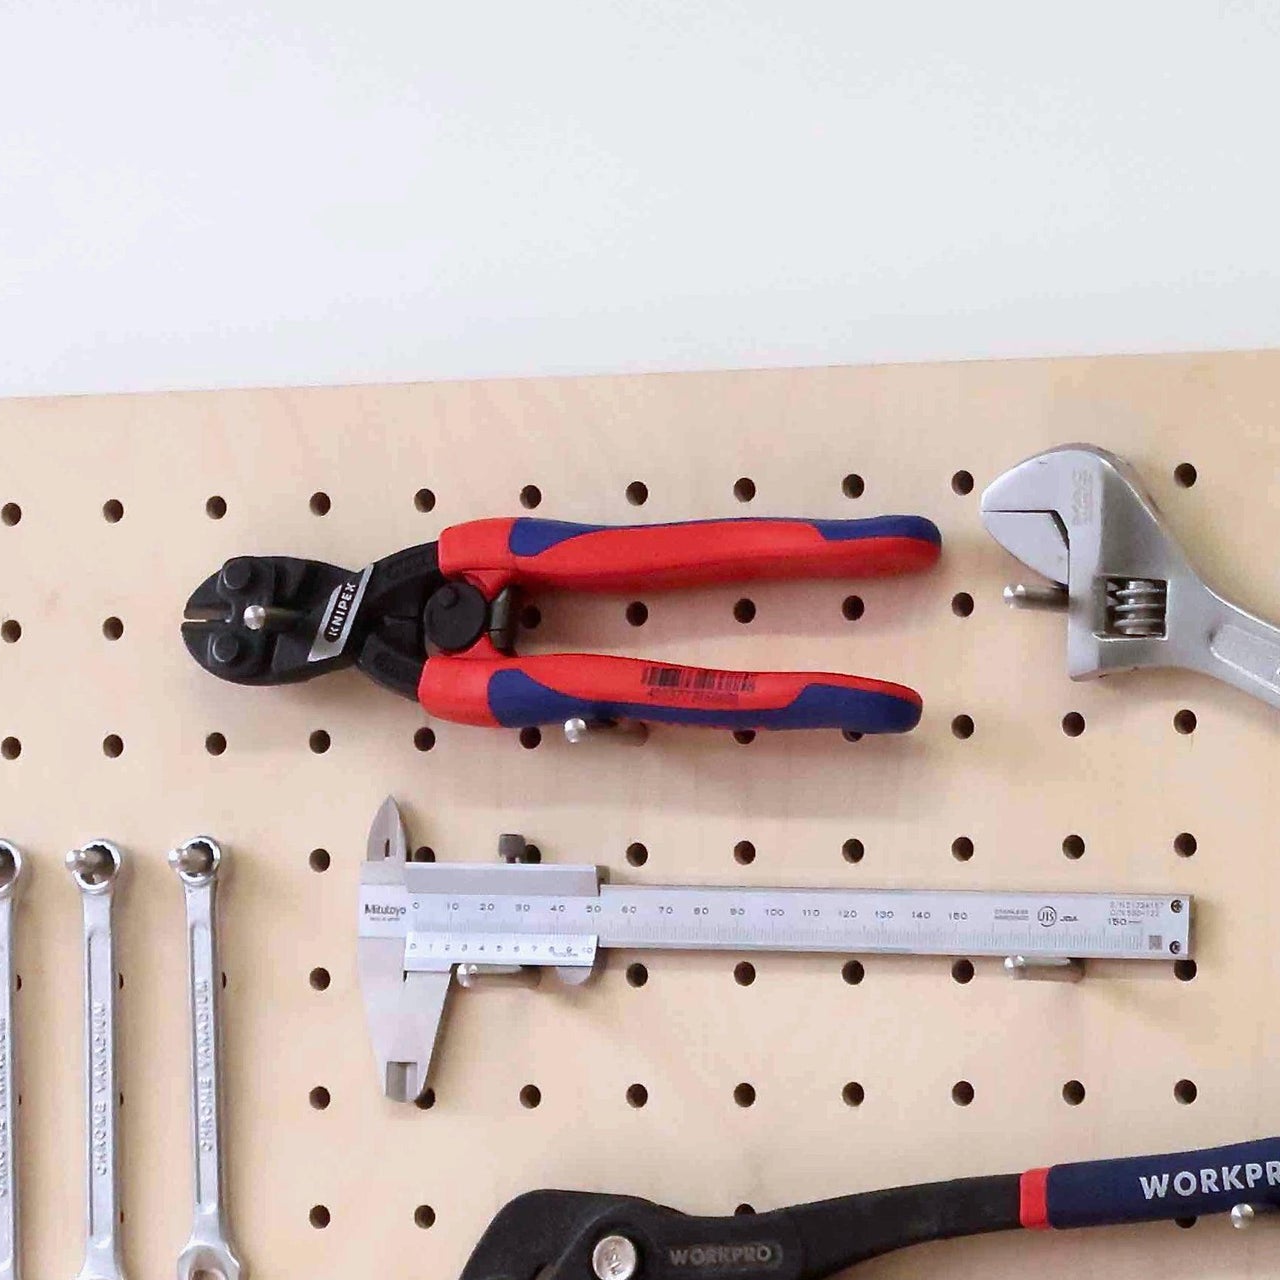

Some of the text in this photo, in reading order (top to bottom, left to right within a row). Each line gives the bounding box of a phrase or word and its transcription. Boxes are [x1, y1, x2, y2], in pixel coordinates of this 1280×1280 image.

[327, 582, 356, 637] KNIPEX
[364, 903, 407, 917] Mitutoyo
[92, 1002, 107, 1176] CHROME VANADIUM
[196, 979, 212, 1152] CHROME VANADIUM
[669, 1244, 772, 1267] WORKPRO
